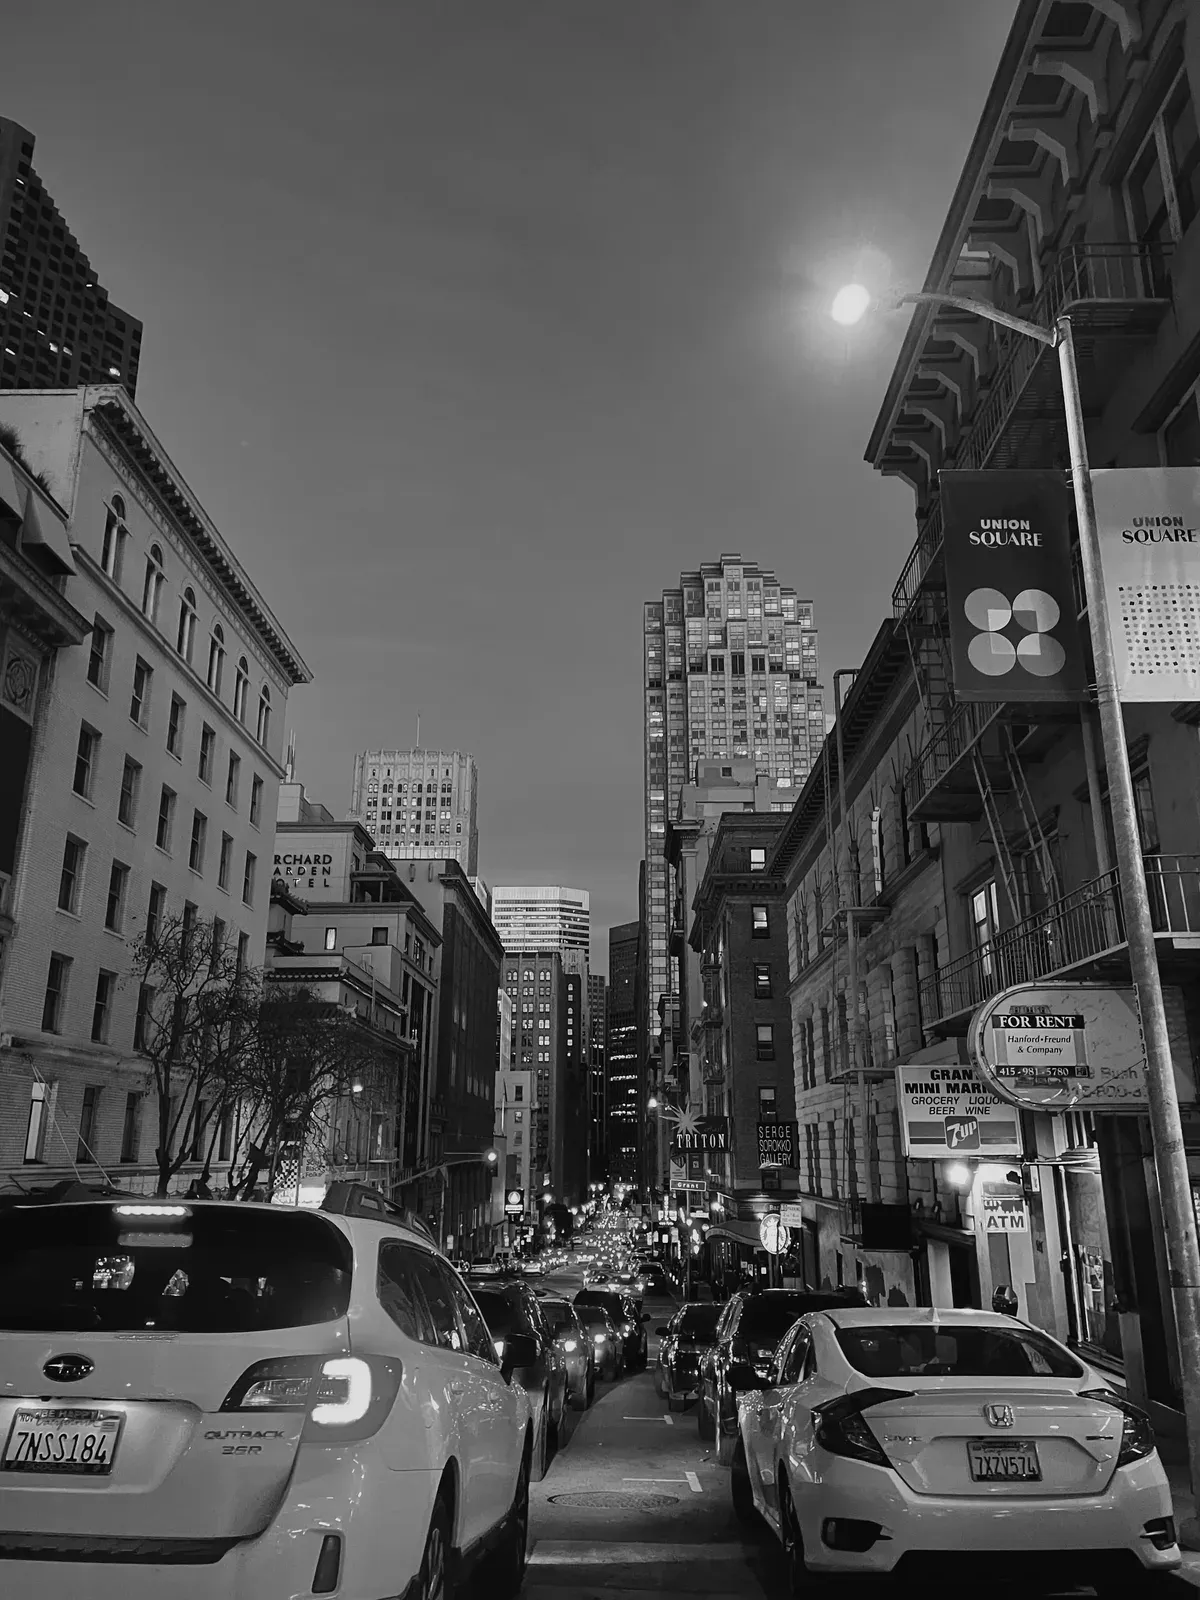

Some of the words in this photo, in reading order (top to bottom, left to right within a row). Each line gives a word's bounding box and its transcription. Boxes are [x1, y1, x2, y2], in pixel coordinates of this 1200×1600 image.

[980, 519, 1030, 530] UNION
[1132, 516, 1184, 527] UNION
[969, 531, 1043, 549] SQUARE
[1122, 528, 1198, 546] SQUARE
[273, 854, 332, 865] RCHARD
[273, 866, 331, 876] ARDEN
[999, 1015, 1031, 1028] FOR
[1035, 1015, 1075, 1028] RENT
[1026, 1045, 1063, 1055] Company
[930, 1069, 980, 1080] GRAN
[905, 1083, 940, 1094] MINI
[911, 1096, 960, 1105] GROCERY
[929, 1106, 956, 1115] BEER
[965, 1106, 991, 1115] WINE
[759, 1125, 791, 1139] SERGE
[676, 1133, 725, 1149] TRITON
[759, 1139, 792, 1152] SOROKKO
[759, 1152, 792, 1166] GALLERY
[677, 1181, 699, 1189] Grant
[987, 1215, 1025, 1229] ATM
[204, 1430, 285, 1440] OUTBACK
[15, 1431, 107, 1463] 7NSS184
[974, 1456, 1037, 1475] 7XZV574
